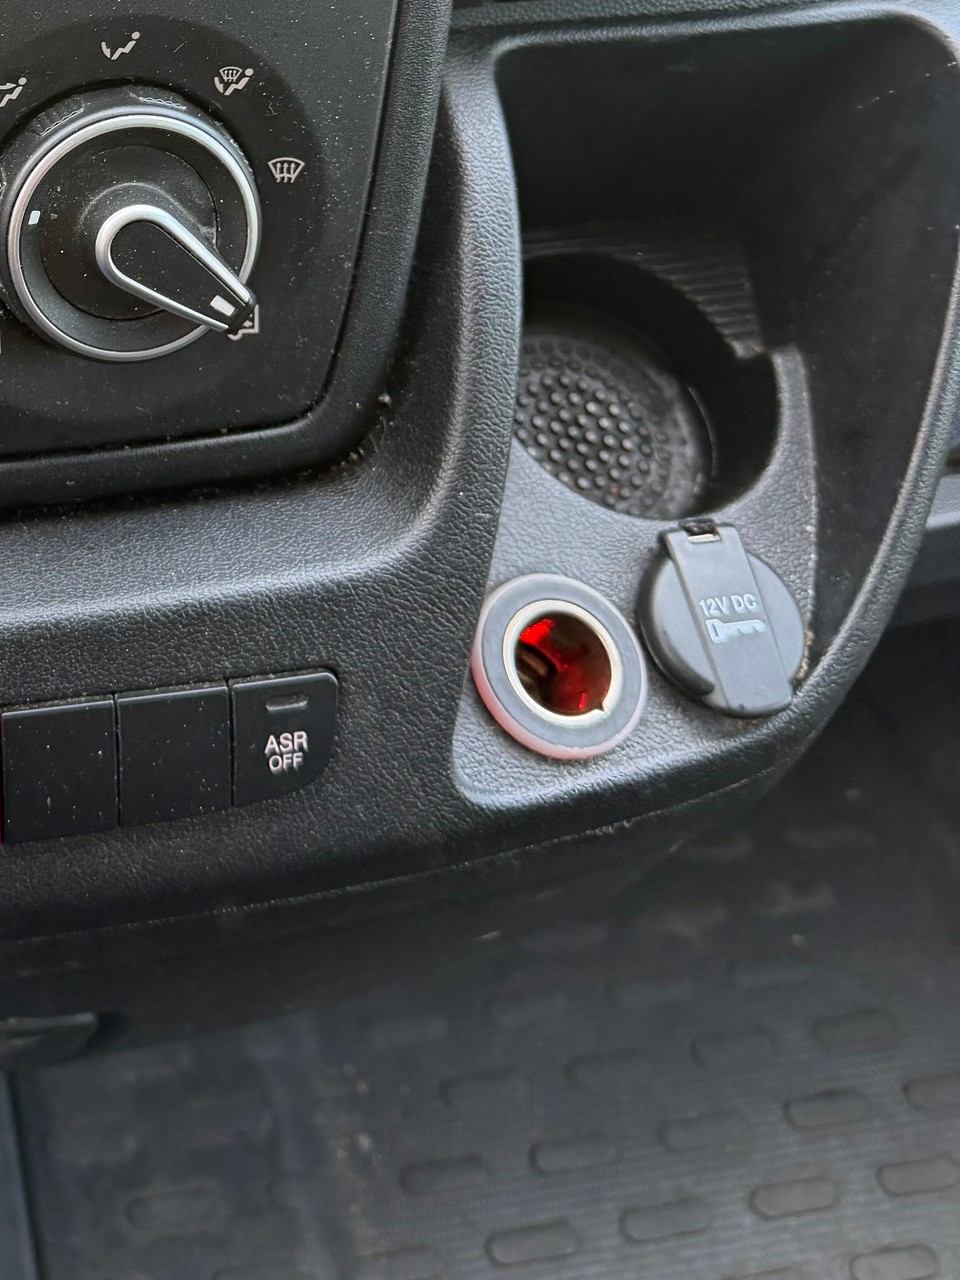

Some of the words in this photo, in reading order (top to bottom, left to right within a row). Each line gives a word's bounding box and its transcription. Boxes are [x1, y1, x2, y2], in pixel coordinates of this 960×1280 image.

[698, 595, 729, 617] 12V
[731, 592, 760, 614] DC
[264, 730, 309, 756] ASR
[268, 752, 304, 774] OFF
